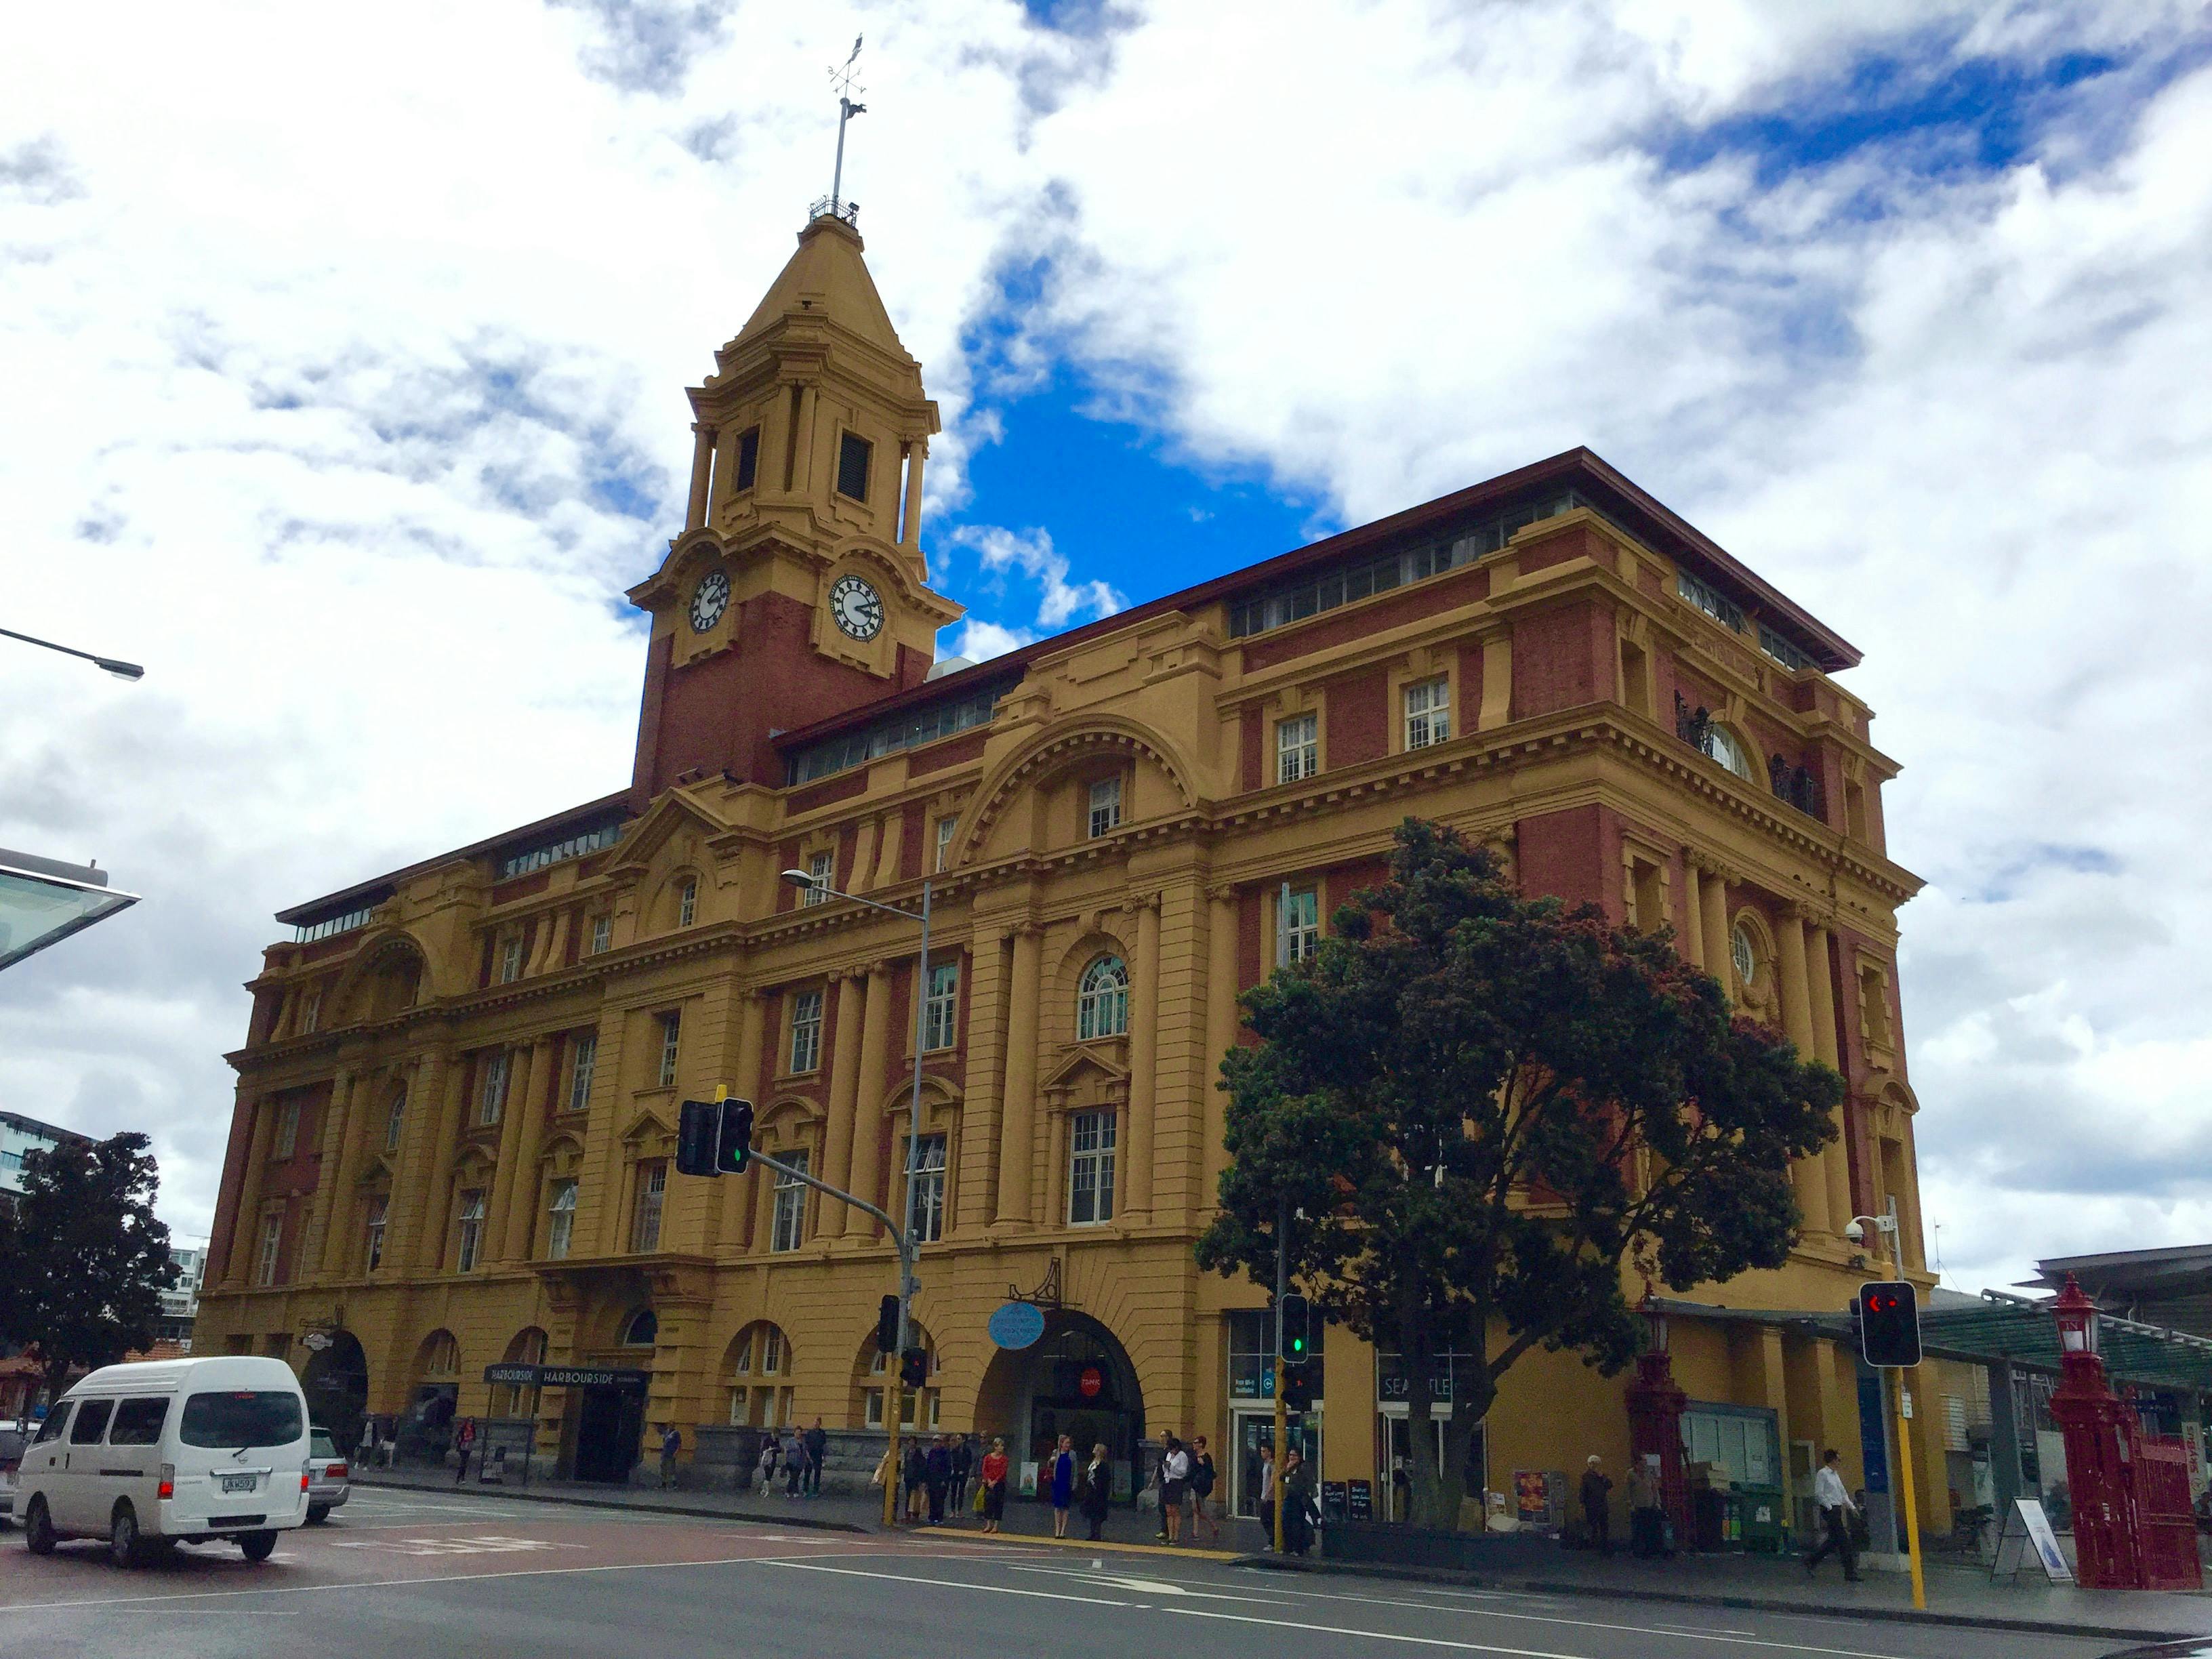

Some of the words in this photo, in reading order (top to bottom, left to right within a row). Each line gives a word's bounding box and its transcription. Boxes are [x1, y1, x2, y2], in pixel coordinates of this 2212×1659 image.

[491, 1370, 533, 1380] HARBOURSIDE
[544, 1372, 613, 1383] HARBOURSIDE
[1385, 1378, 1450, 1395] SEATLE
